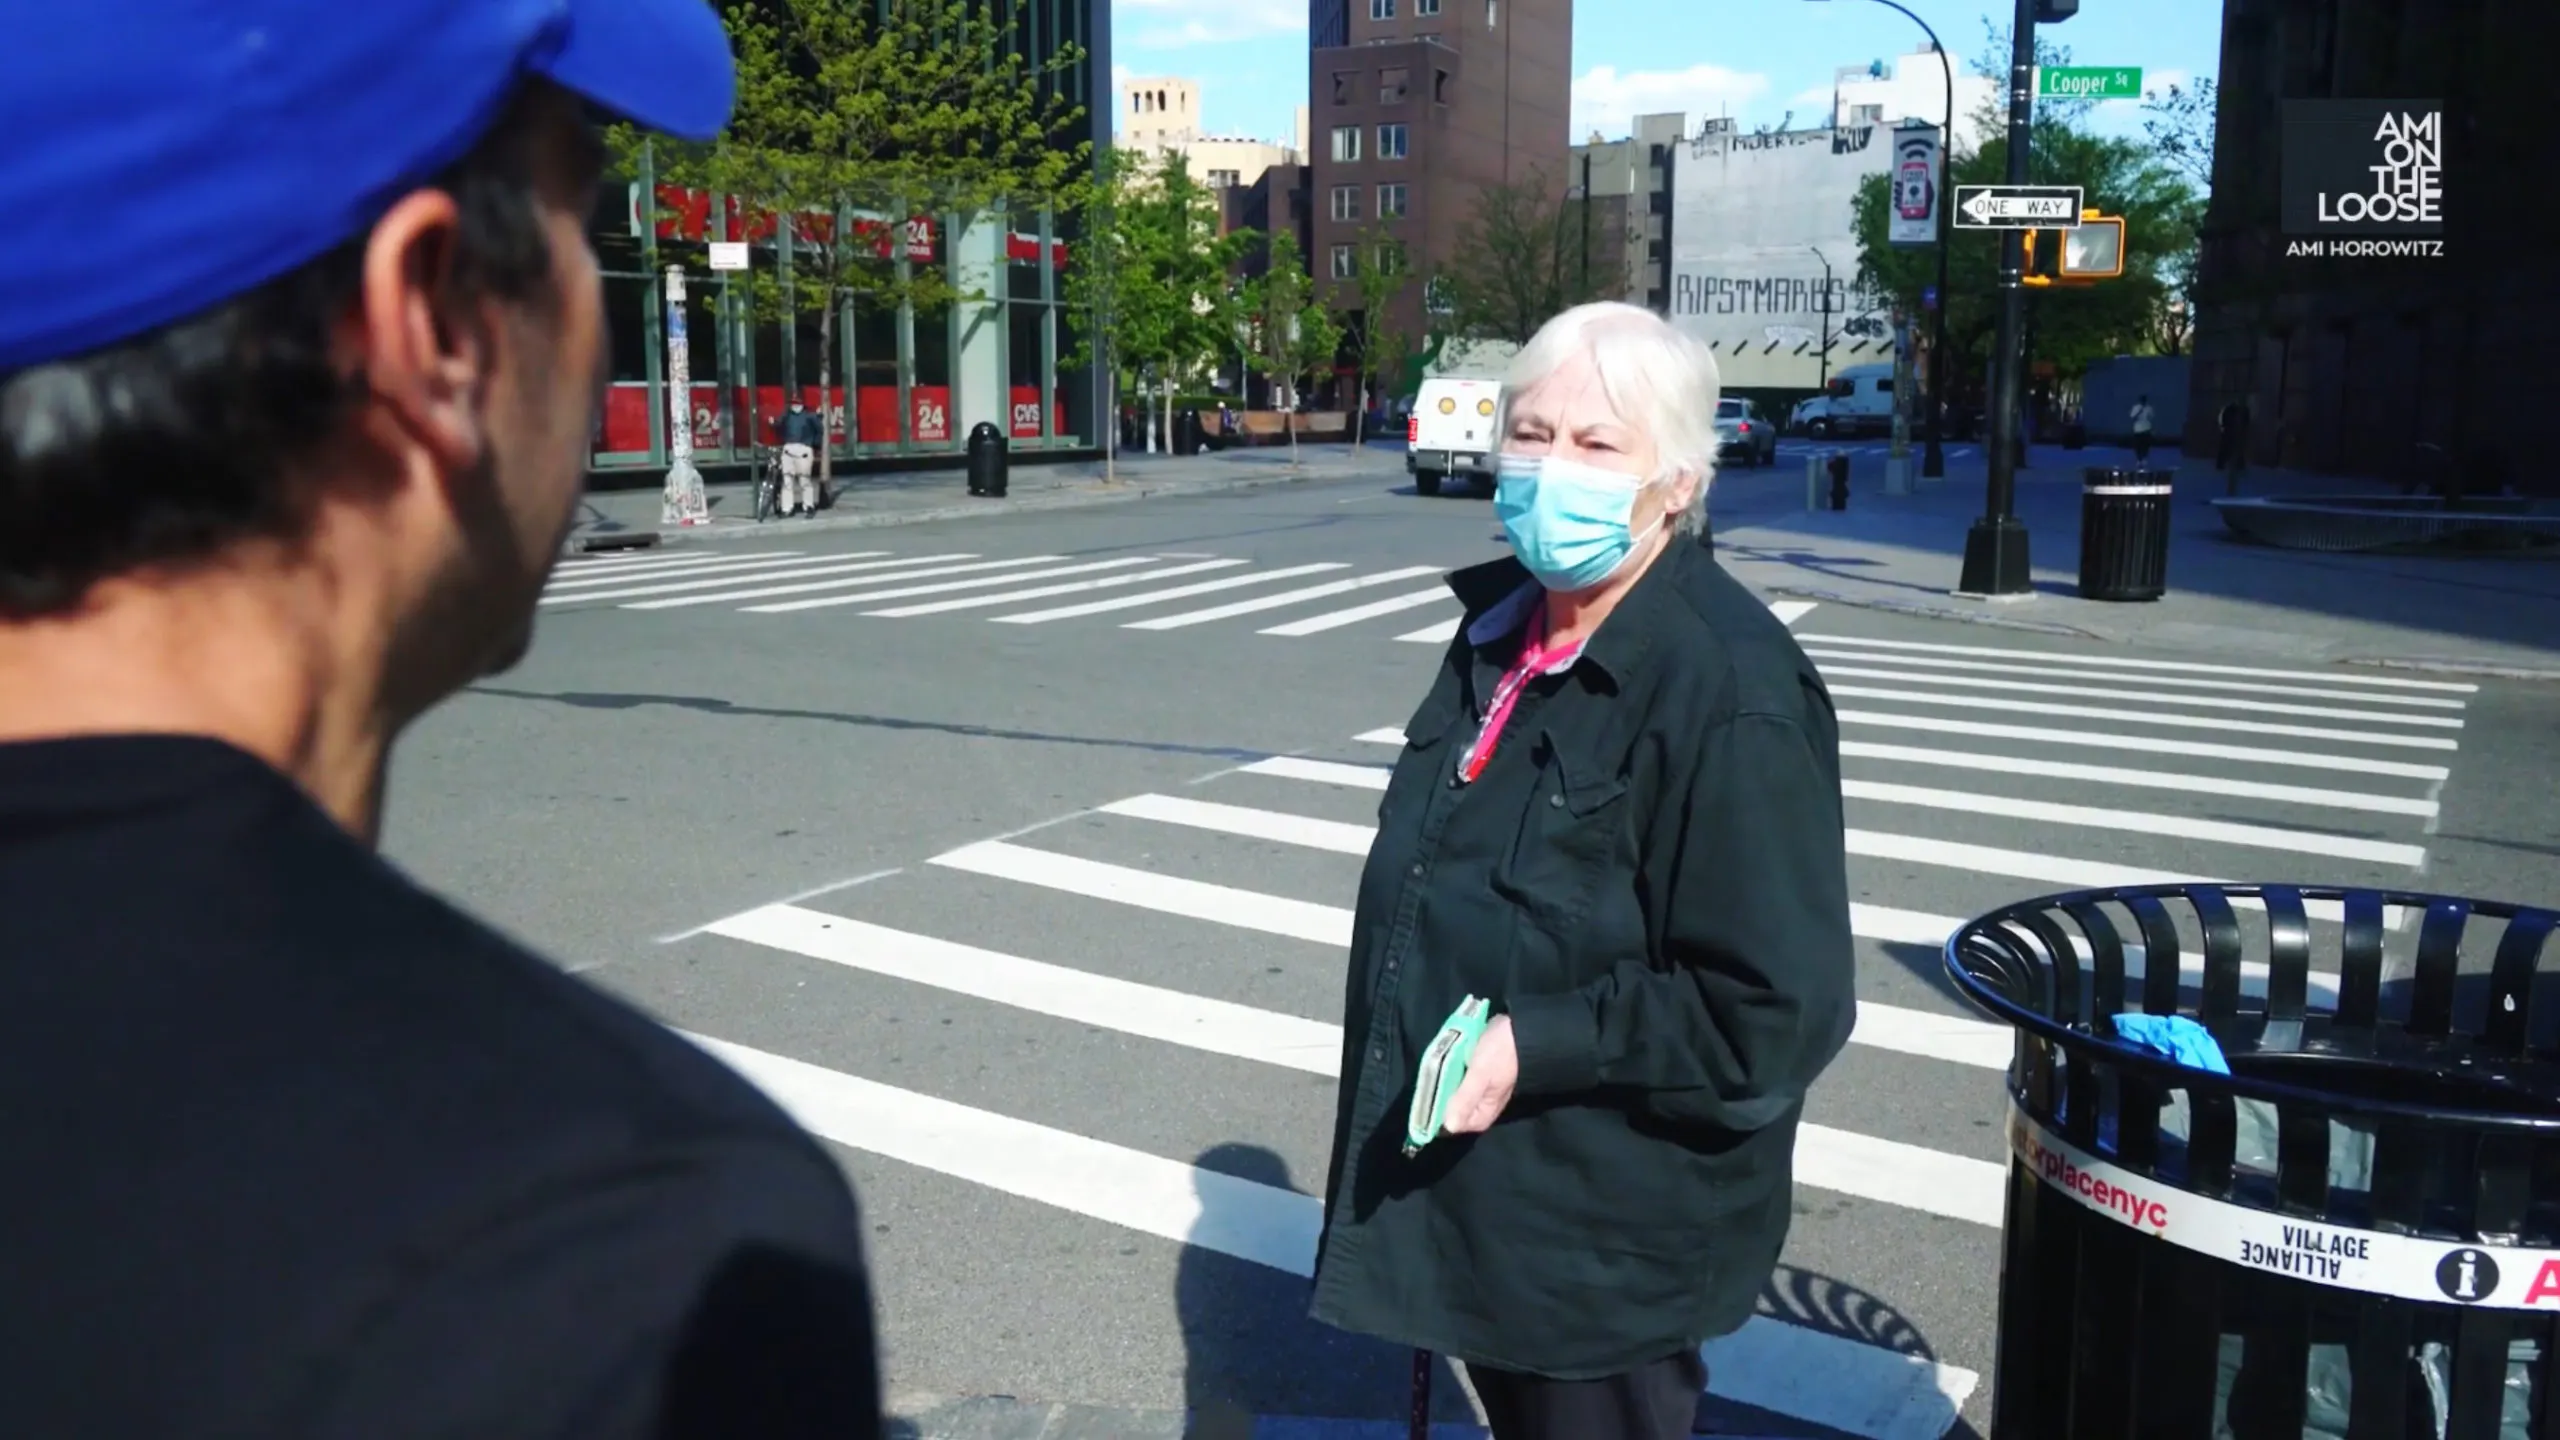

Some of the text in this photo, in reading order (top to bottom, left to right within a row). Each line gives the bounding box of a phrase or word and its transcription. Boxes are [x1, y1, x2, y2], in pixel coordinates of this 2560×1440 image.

[2050, 71, 2128, 98] Cooper Sq
[1975, 199, 2064, 215] ONE WAY
[906, 219, 928, 244] 24
[918, 404, 944, 428] 24
[1014, 403, 1040, 422] CVS
[2283, 1225, 2370, 1260] VILLAGE
[2241, 1240, 2341, 1280] ALLIANCE
